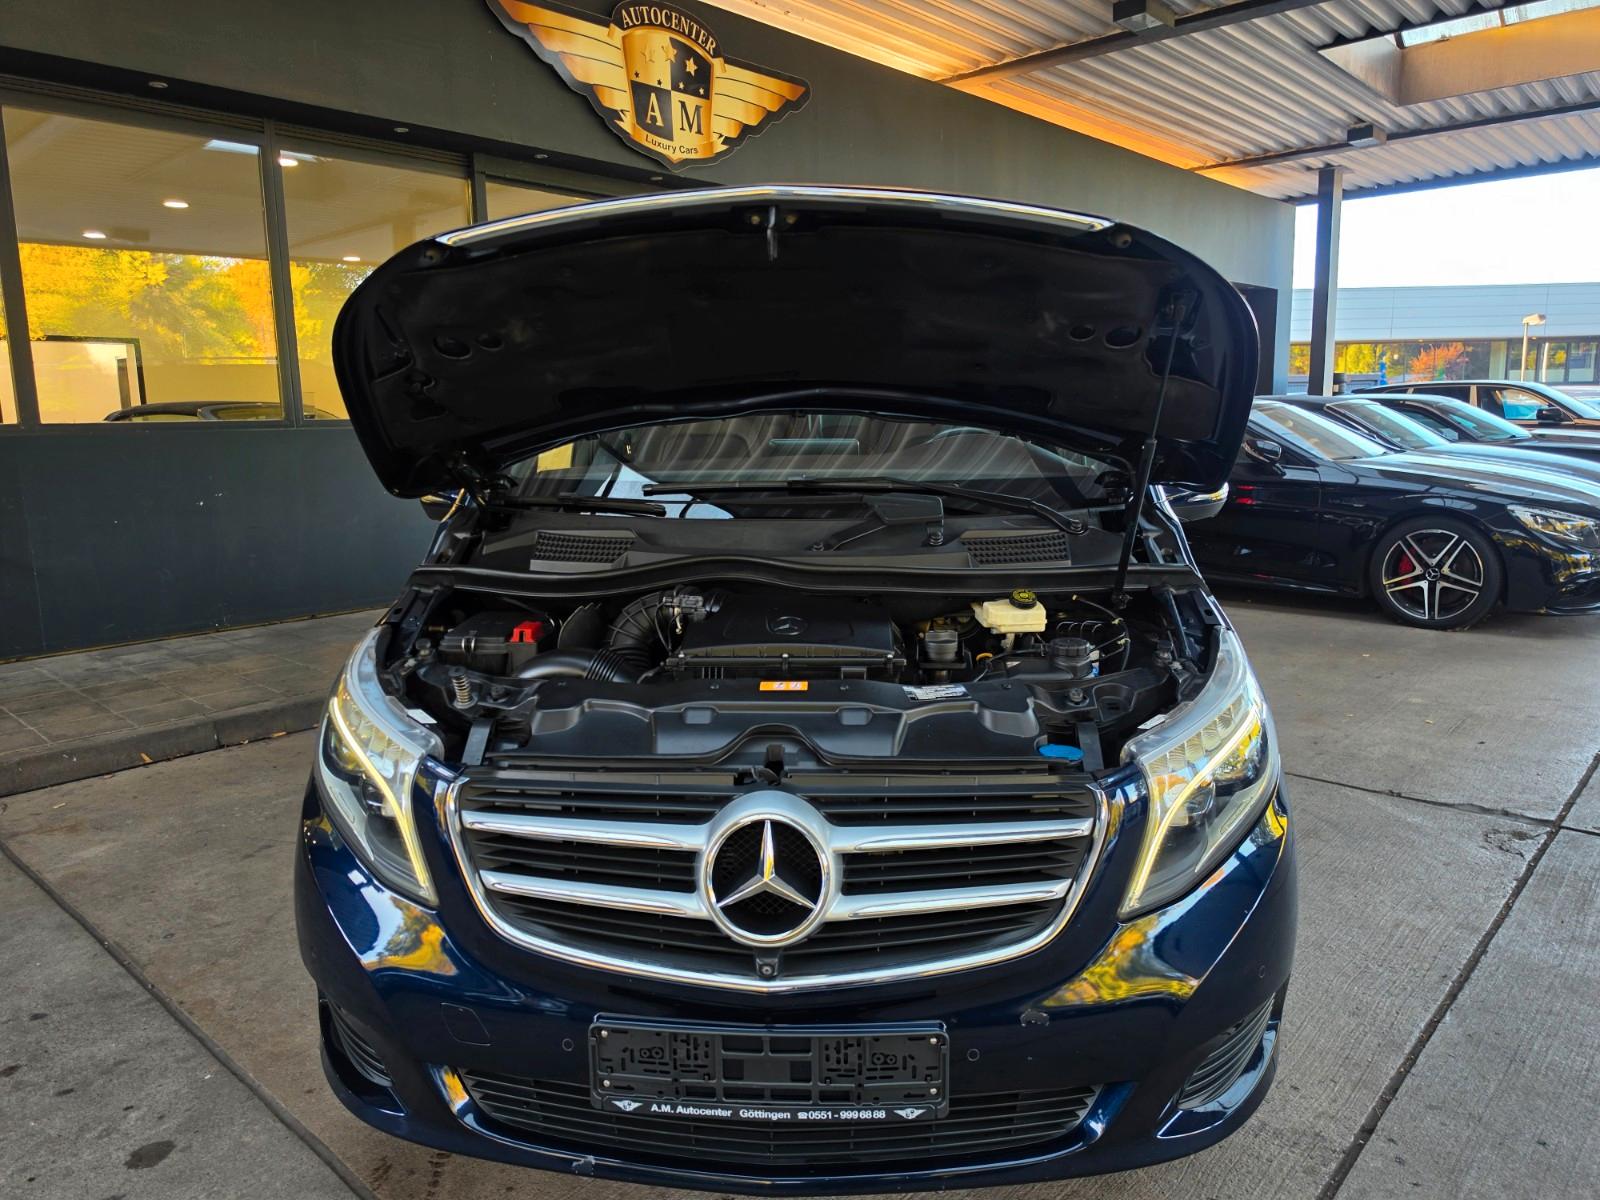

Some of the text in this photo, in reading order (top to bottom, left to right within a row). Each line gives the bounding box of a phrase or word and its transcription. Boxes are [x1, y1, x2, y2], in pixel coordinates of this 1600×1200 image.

[621, 6, 717, 56] AUTOCENTER
[645, 92, 704, 135] A M
[645, 134, 699, 155] Luxury Cars
[651, 1103, 674, 1113] A.M.
[676, 1105, 733, 1117] Autocenter
[739, 1108, 791, 1121] Göttingen
